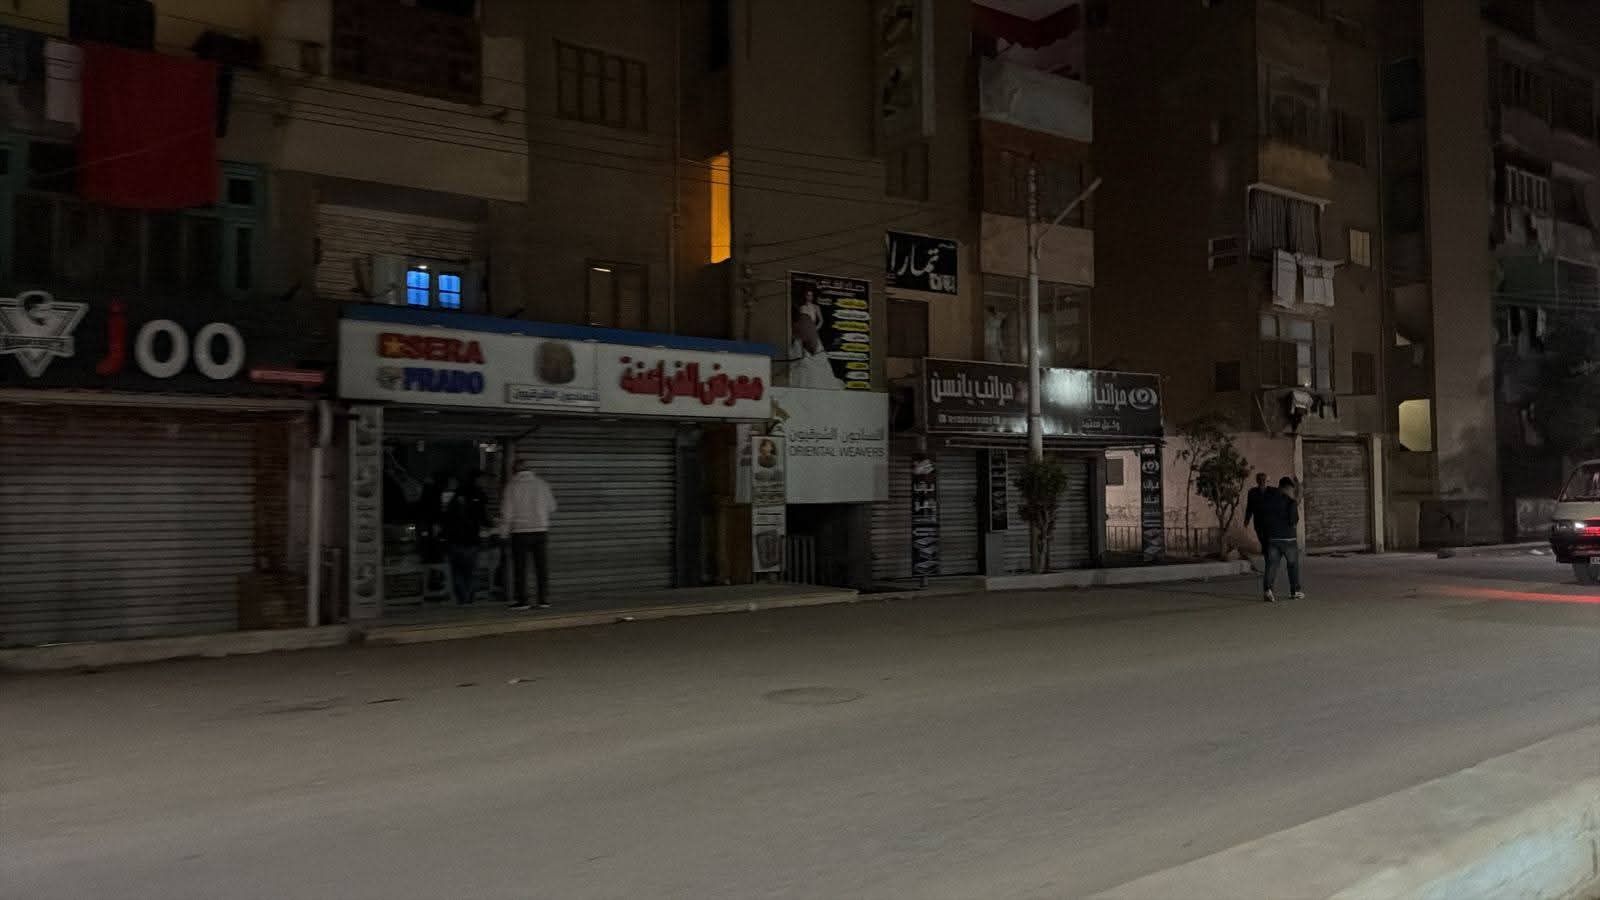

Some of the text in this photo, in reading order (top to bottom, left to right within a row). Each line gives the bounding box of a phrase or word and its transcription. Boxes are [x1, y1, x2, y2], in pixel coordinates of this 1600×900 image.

[620, 356, 763, 406] معرض الفراعنة
[930, 371, 975, 406] يانسن
[975, 375, 1014, 407] مراتب
[1094, 383, 1128, 411] مراتب
[789, 427, 838, 443] الشرقيون
[789, 445, 886, 458] ORIENTAL WEAVERS
